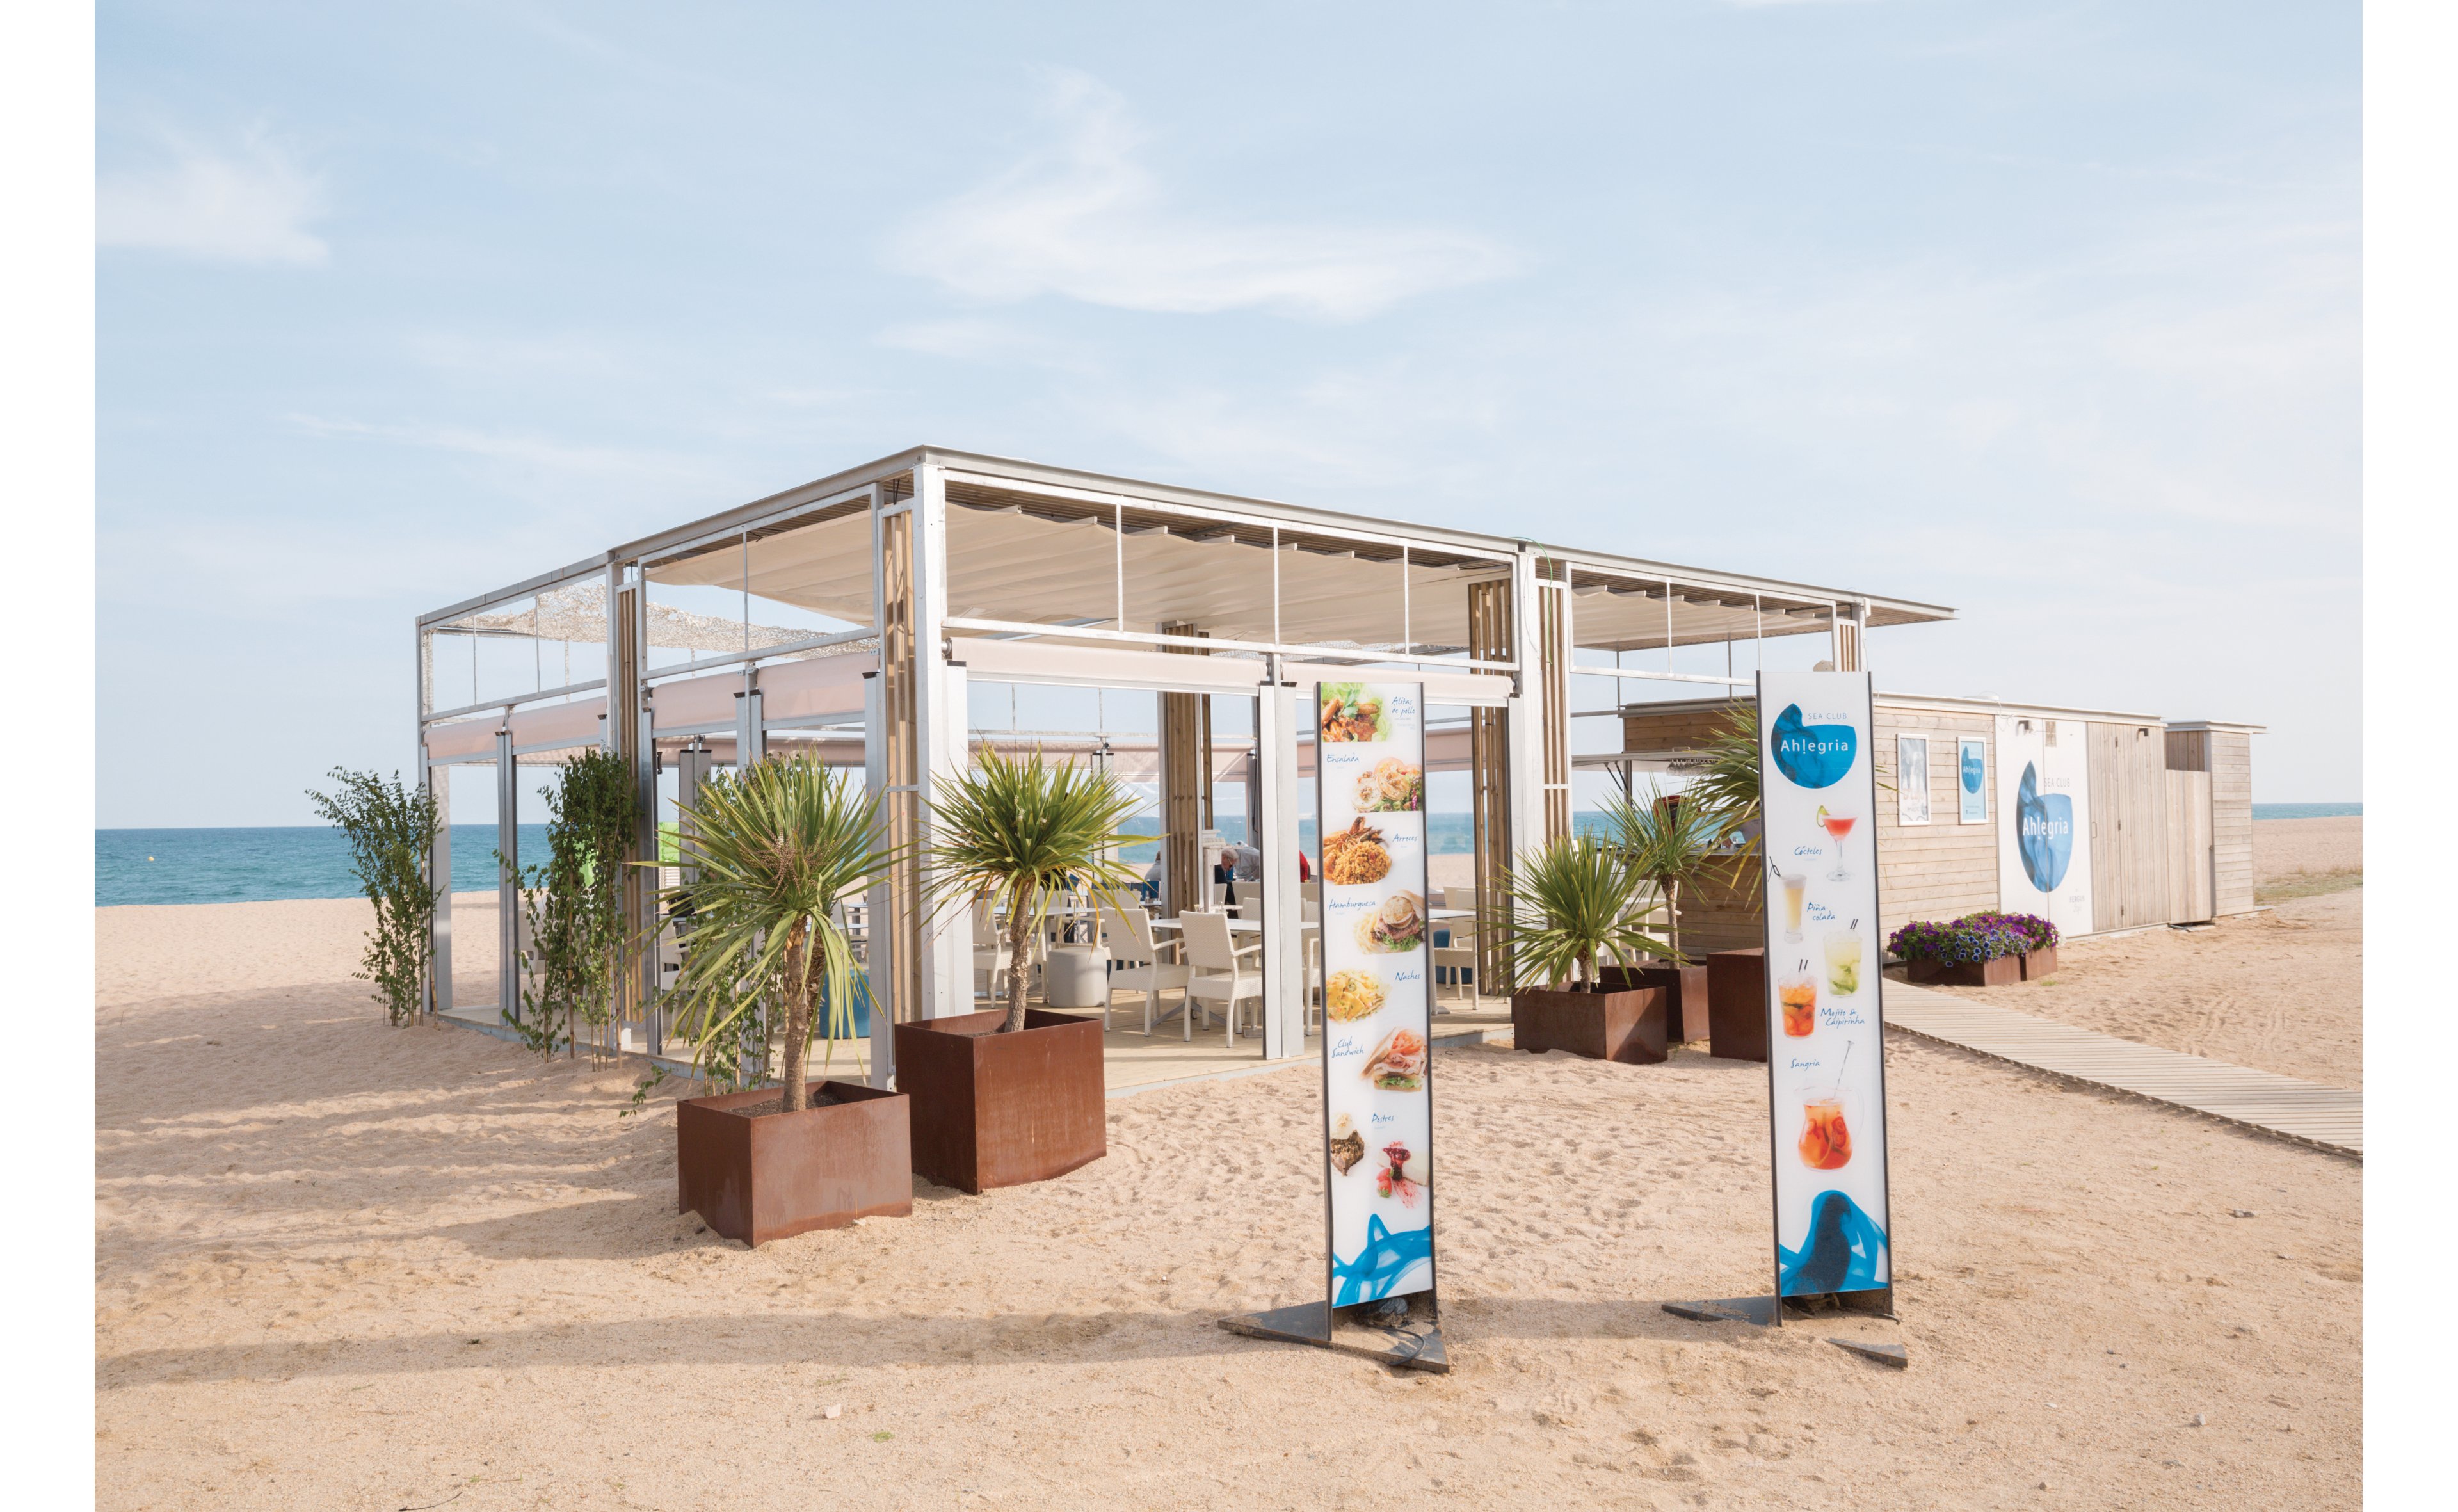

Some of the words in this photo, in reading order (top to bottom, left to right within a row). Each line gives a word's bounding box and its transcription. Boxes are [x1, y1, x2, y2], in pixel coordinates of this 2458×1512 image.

[1392, 696, 1413, 705] Alitas
[1392, 704, 1398, 713] de
[1400, 706, 1415, 717] pollo
[1326, 753, 1359, 763] Ensalada
[2044, 778, 2055, 787] SEA
[2056, 778, 2070, 787] CLUB
[1392, 833, 1418, 842] Arroces
[1794, 846, 1822, 855] Cócteles
[1329, 897, 1376, 911] Hamburguesa
[1807, 902, 1826, 912] Piña
[1812, 911, 1836, 921] colada
[1395, 970, 1420, 981] Nachos
[1820, 1008, 1846, 1018] Mojito
[1826, 1015, 1865, 1029] Caipirinha
[1337, 1036, 1353, 1048] Club
[1332, 1045, 1364, 1058] Sandwich
[1372, 1113, 1394, 1123] Postres
